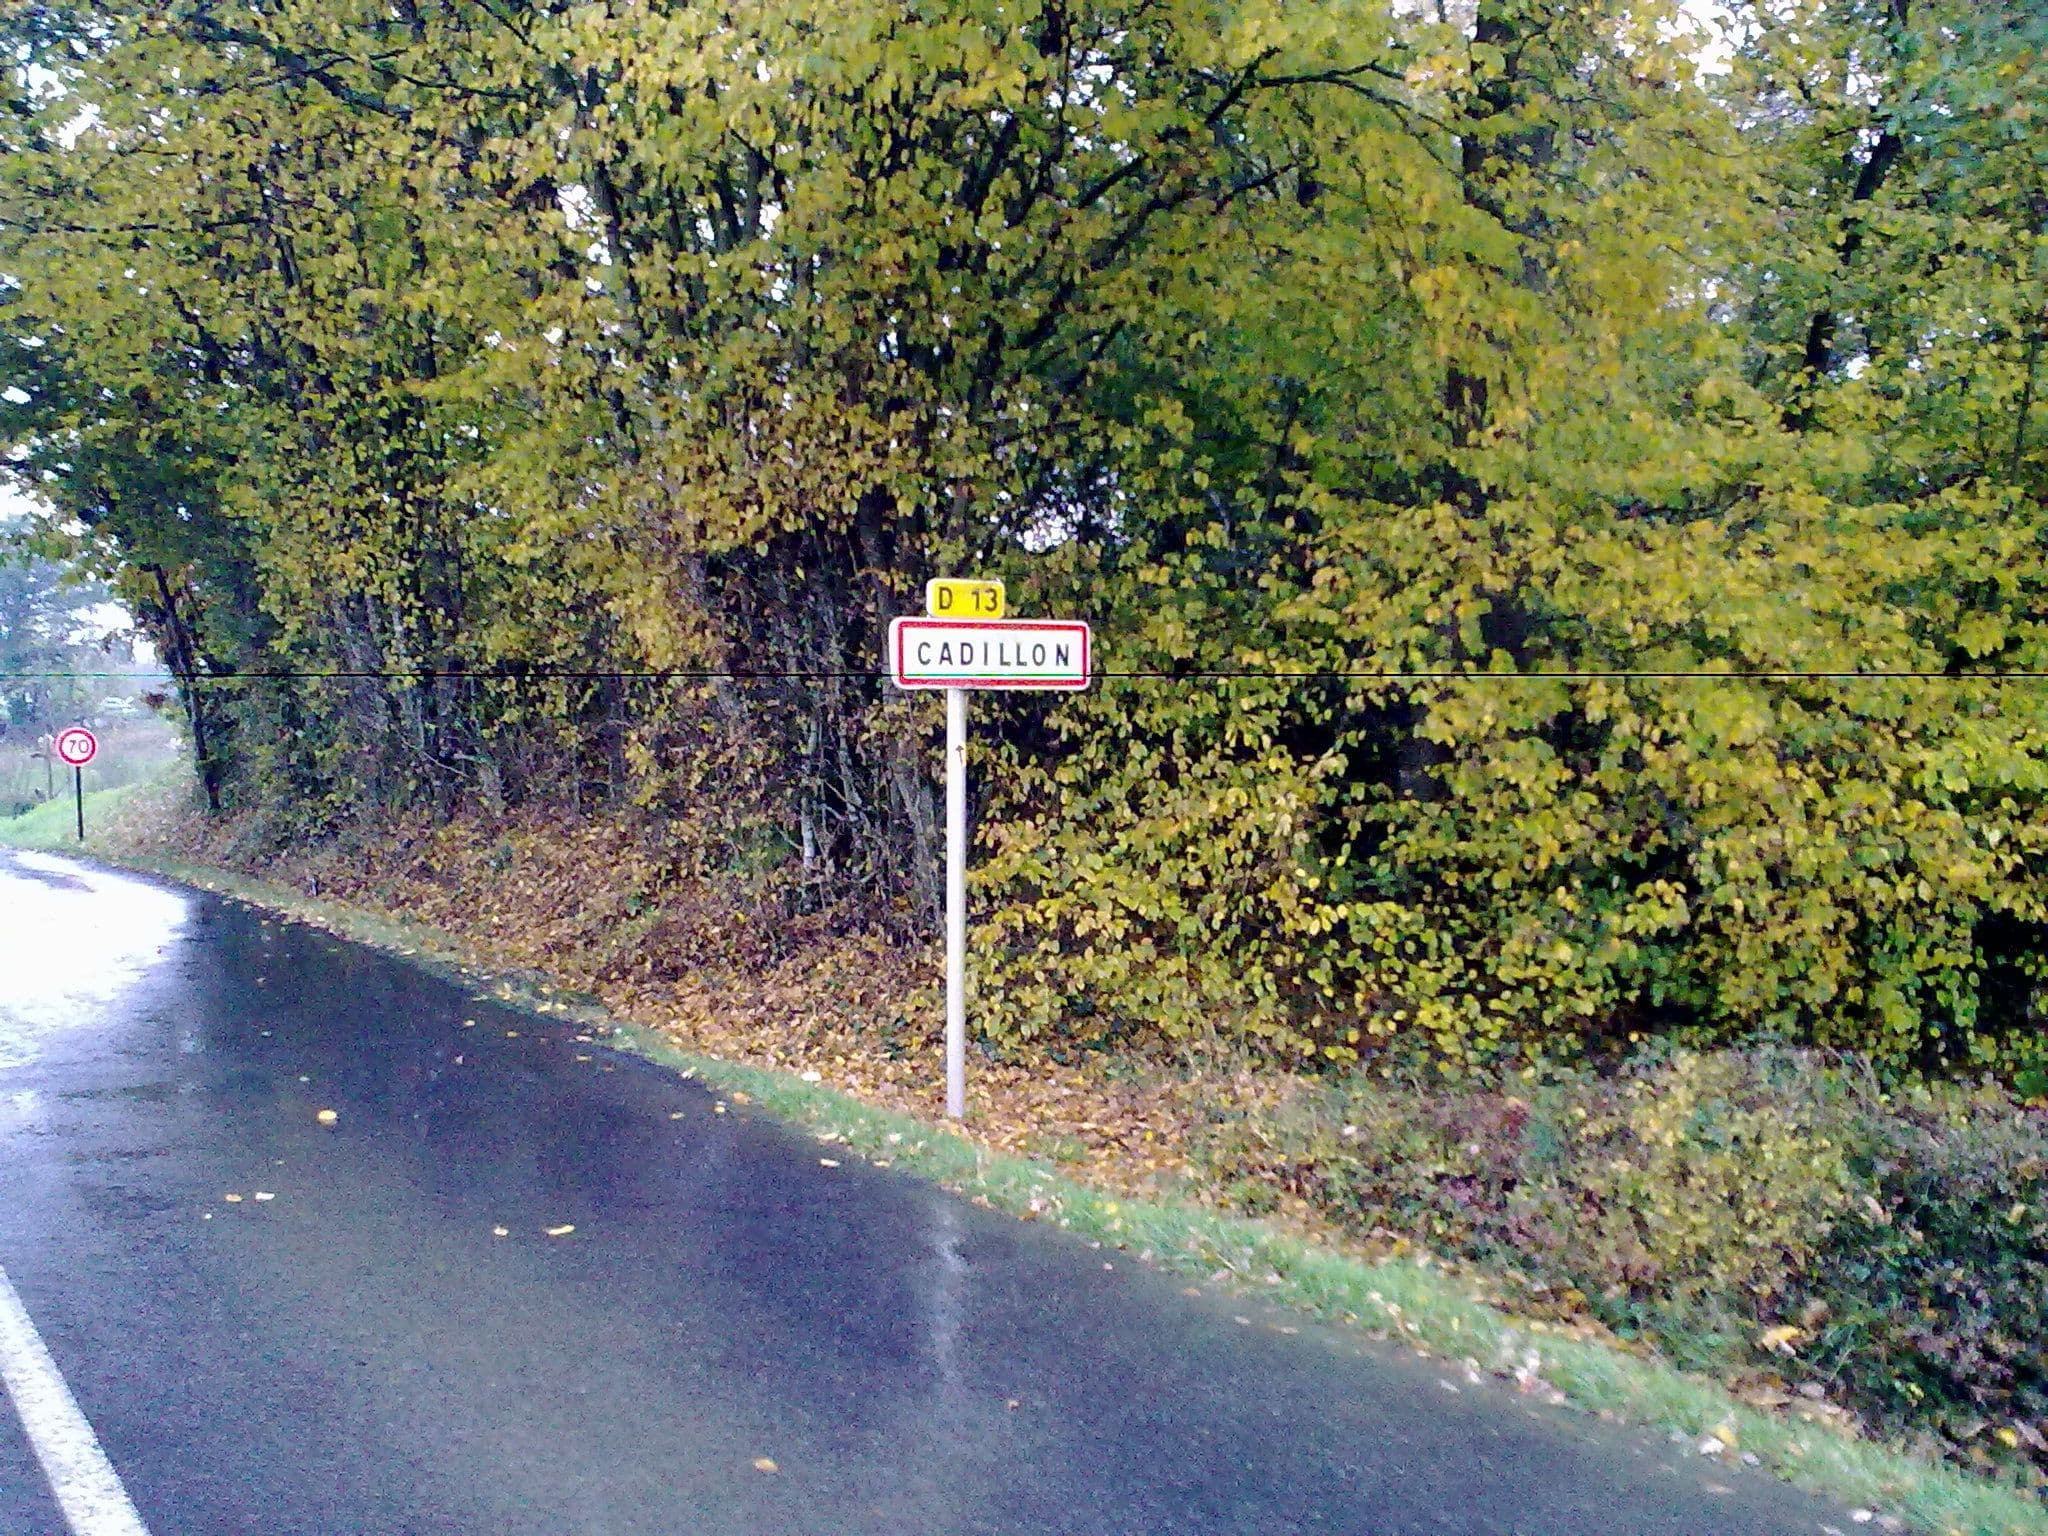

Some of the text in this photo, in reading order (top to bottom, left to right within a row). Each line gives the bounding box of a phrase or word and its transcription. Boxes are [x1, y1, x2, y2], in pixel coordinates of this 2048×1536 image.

[938, 587, 998, 612] D 13
[917, 641, 1069, 667] CADILLON
[69, 739, 89, 753] 70
